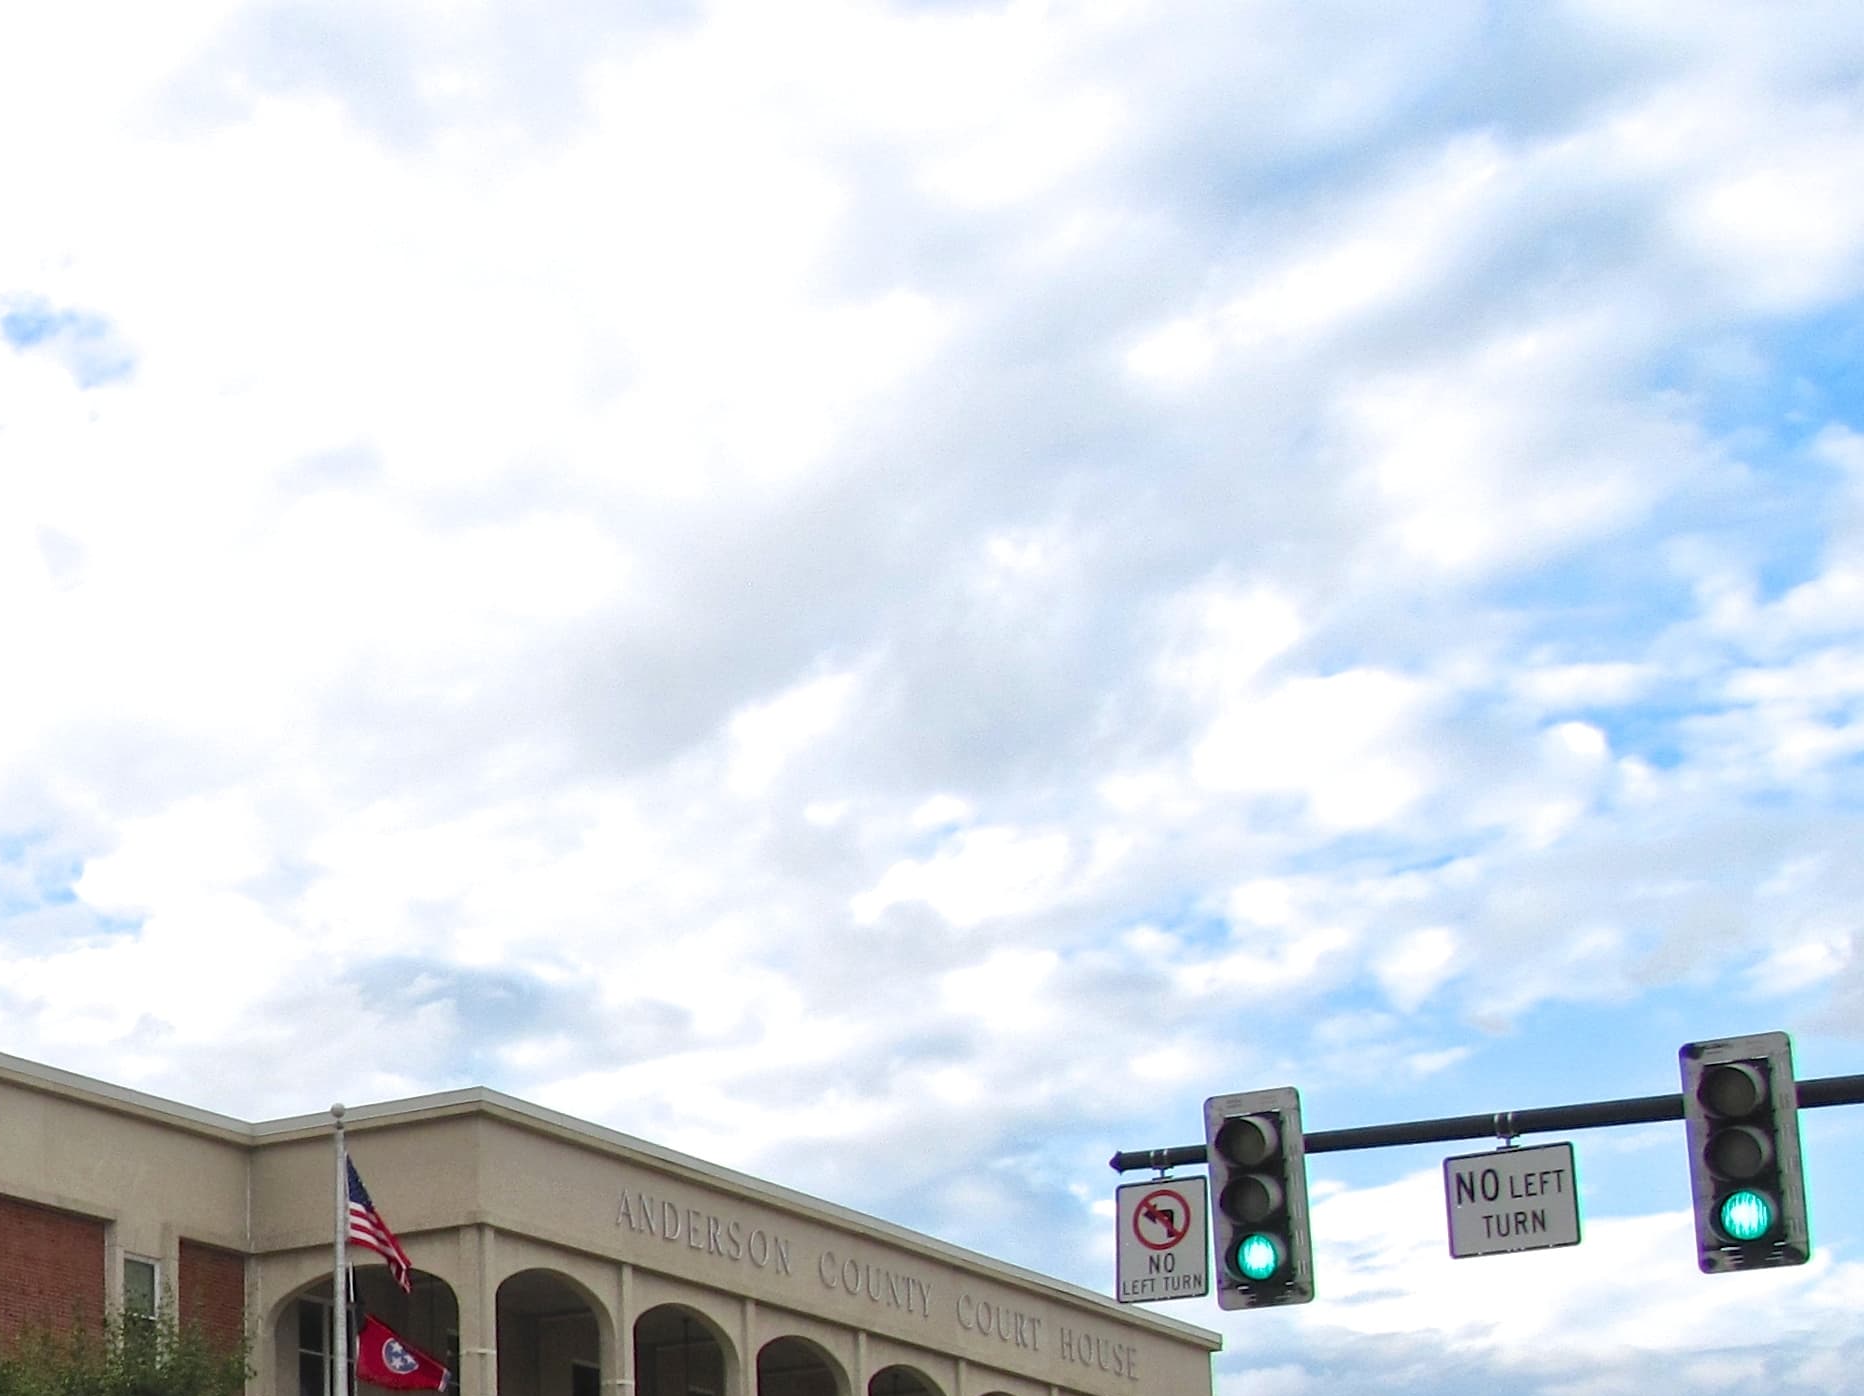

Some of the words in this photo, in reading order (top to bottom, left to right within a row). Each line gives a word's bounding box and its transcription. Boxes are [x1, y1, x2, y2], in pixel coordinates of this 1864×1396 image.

[1456, 1168, 1499, 1205] NO
[1509, 1169, 1565, 1199] LEFT
[1481, 1209, 1547, 1239] TURN
[1149, 1253, 1175, 1275] NO
[616, 1189, 792, 1275] ANDERSON
[819, 1250, 933, 1318] COUNTY
[956, 1294, 1041, 1352] COURT
[1060, 1327, 1140, 1381] HOUSE
[1122, 1278, 1156, 1296] LEFT
[1163, 1273, 1202, 1292] TURN
